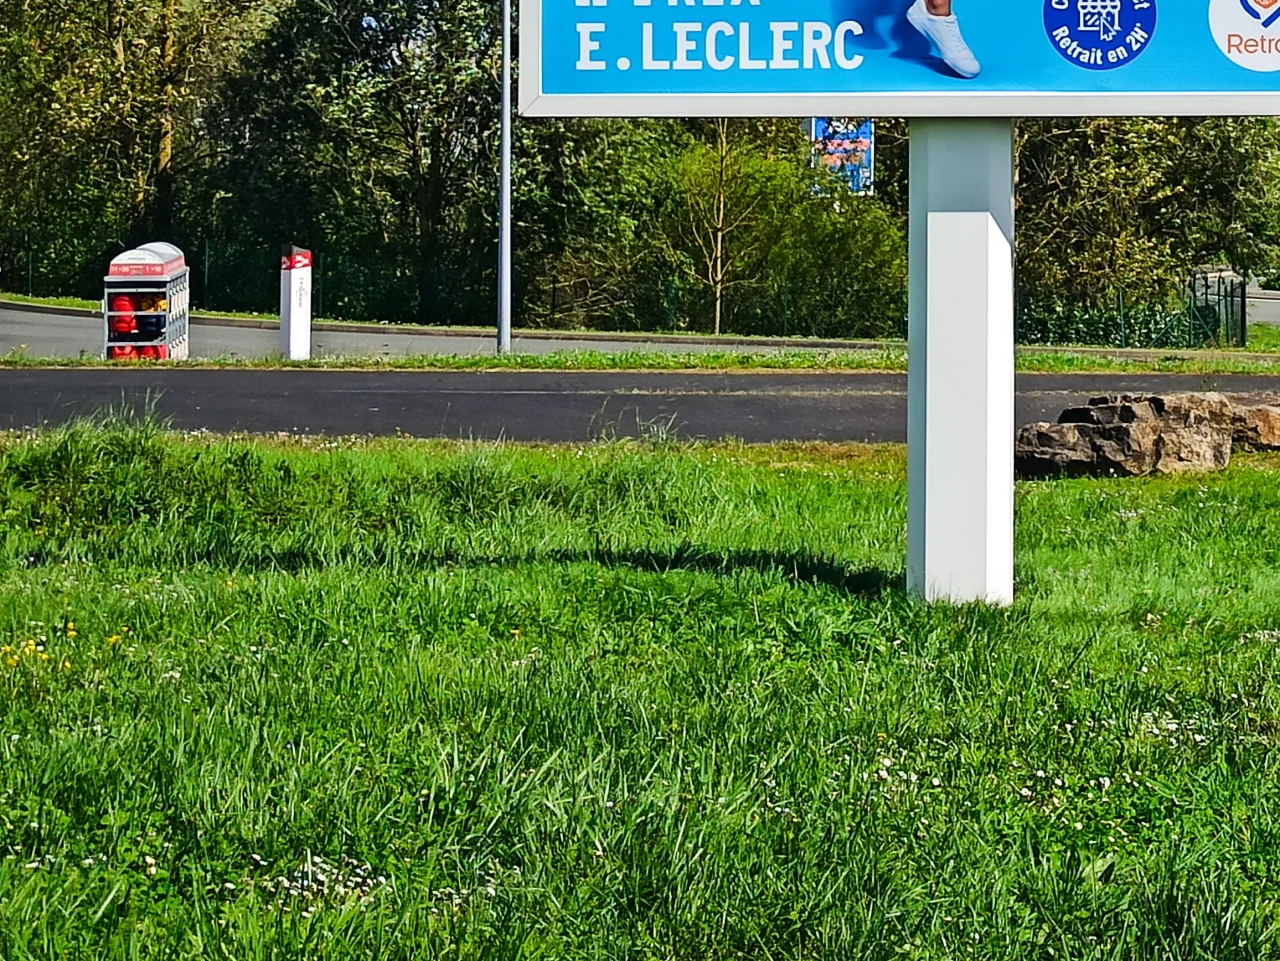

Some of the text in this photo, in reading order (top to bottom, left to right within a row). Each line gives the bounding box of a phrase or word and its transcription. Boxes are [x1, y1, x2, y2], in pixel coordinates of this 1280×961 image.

[576, 21, 864, 71] E.LECLERC
[1052, 25, 1103, 65] Retrait
[1107, 46, 1128, 63] en
